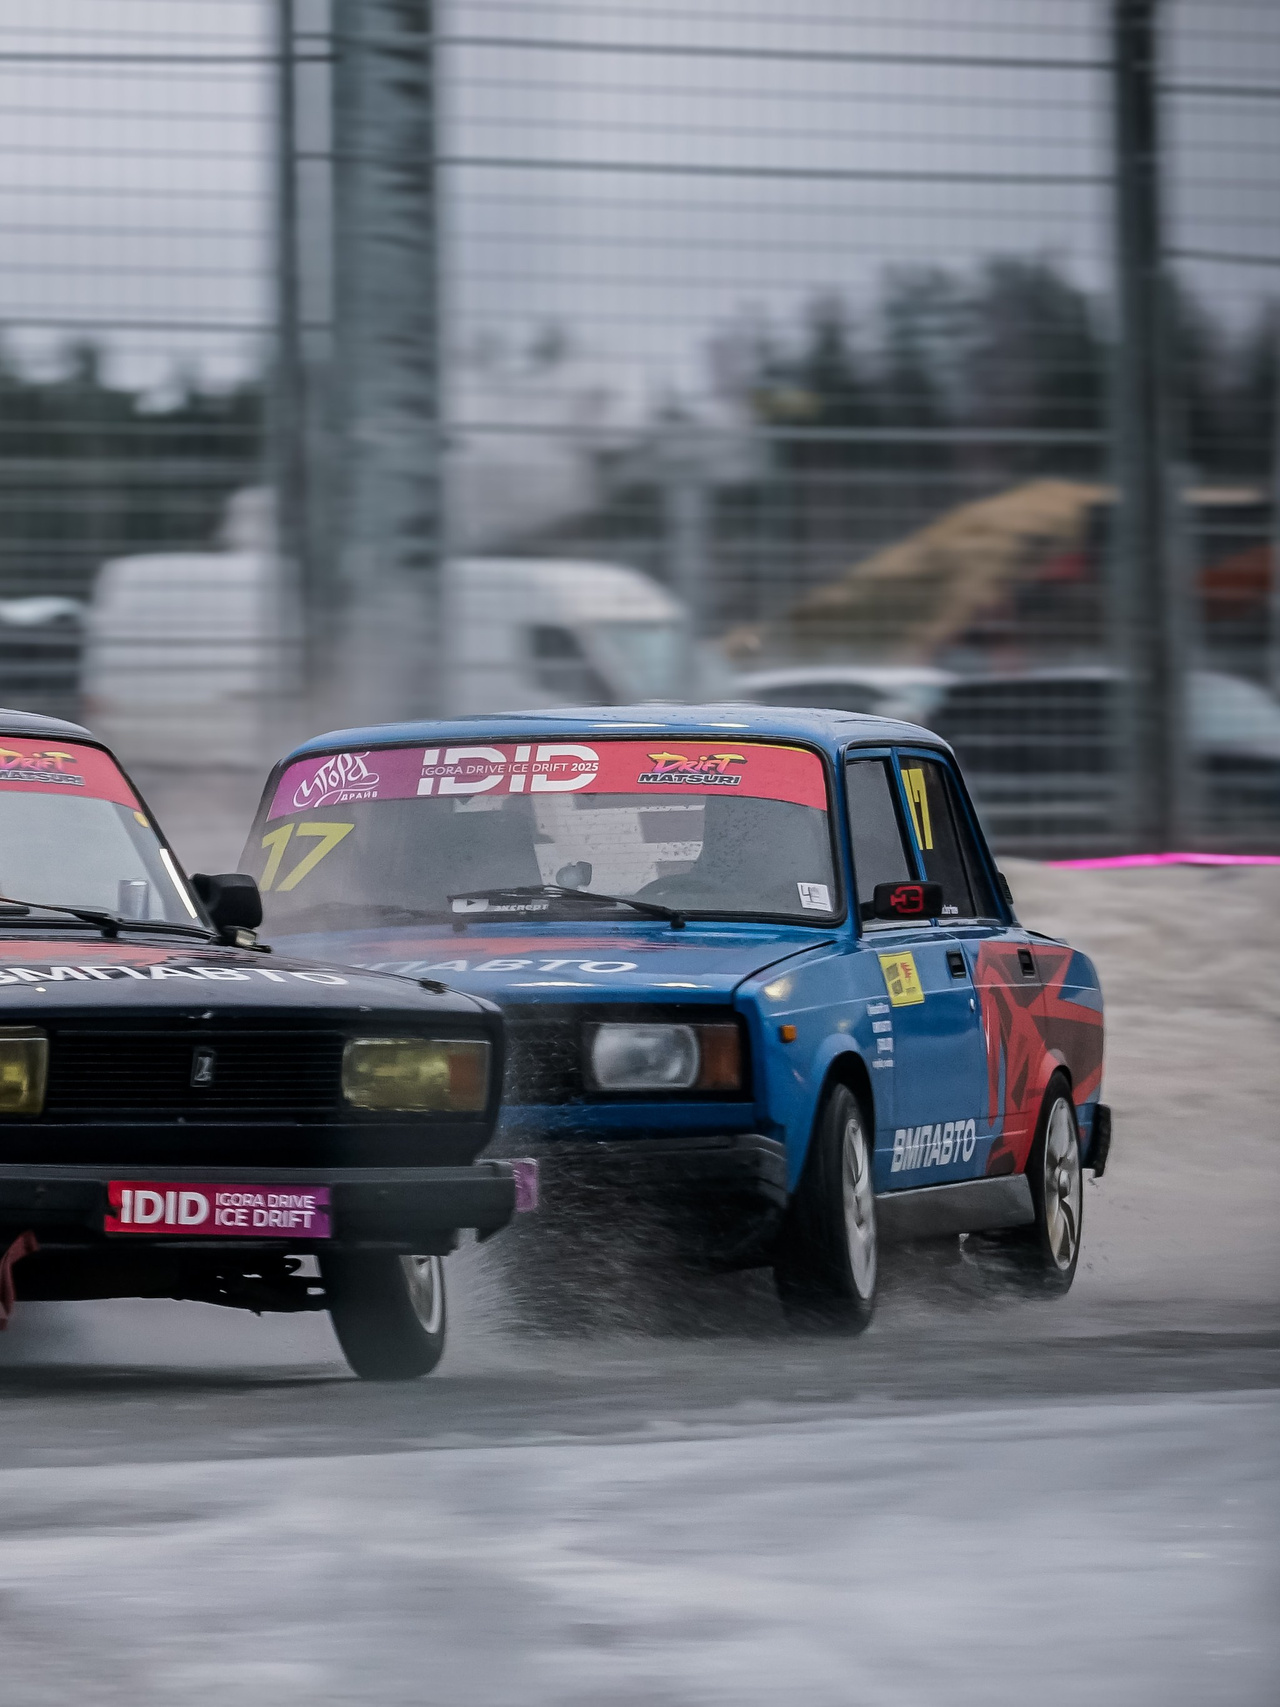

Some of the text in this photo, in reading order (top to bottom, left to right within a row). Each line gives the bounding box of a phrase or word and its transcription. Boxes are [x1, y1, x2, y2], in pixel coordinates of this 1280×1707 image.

[417, 745, 600, 795] IDID
[421, 761, 599, 777] IGORA DRIVE ICE DRIFT 2025
[637, 772, 742, 786] MATSURI
[340, 791, 378, 802] ДРАЙВ
[259, 823, 354, 891] 17
[890, 1119, 976, 1172] ВМПАВТО
[121, 1190, 209, 1225] IDID
[216, 1193, 316, 1209] IGORA DRIVE
[214, 1208, 316, 1229] ICE DRIFT
